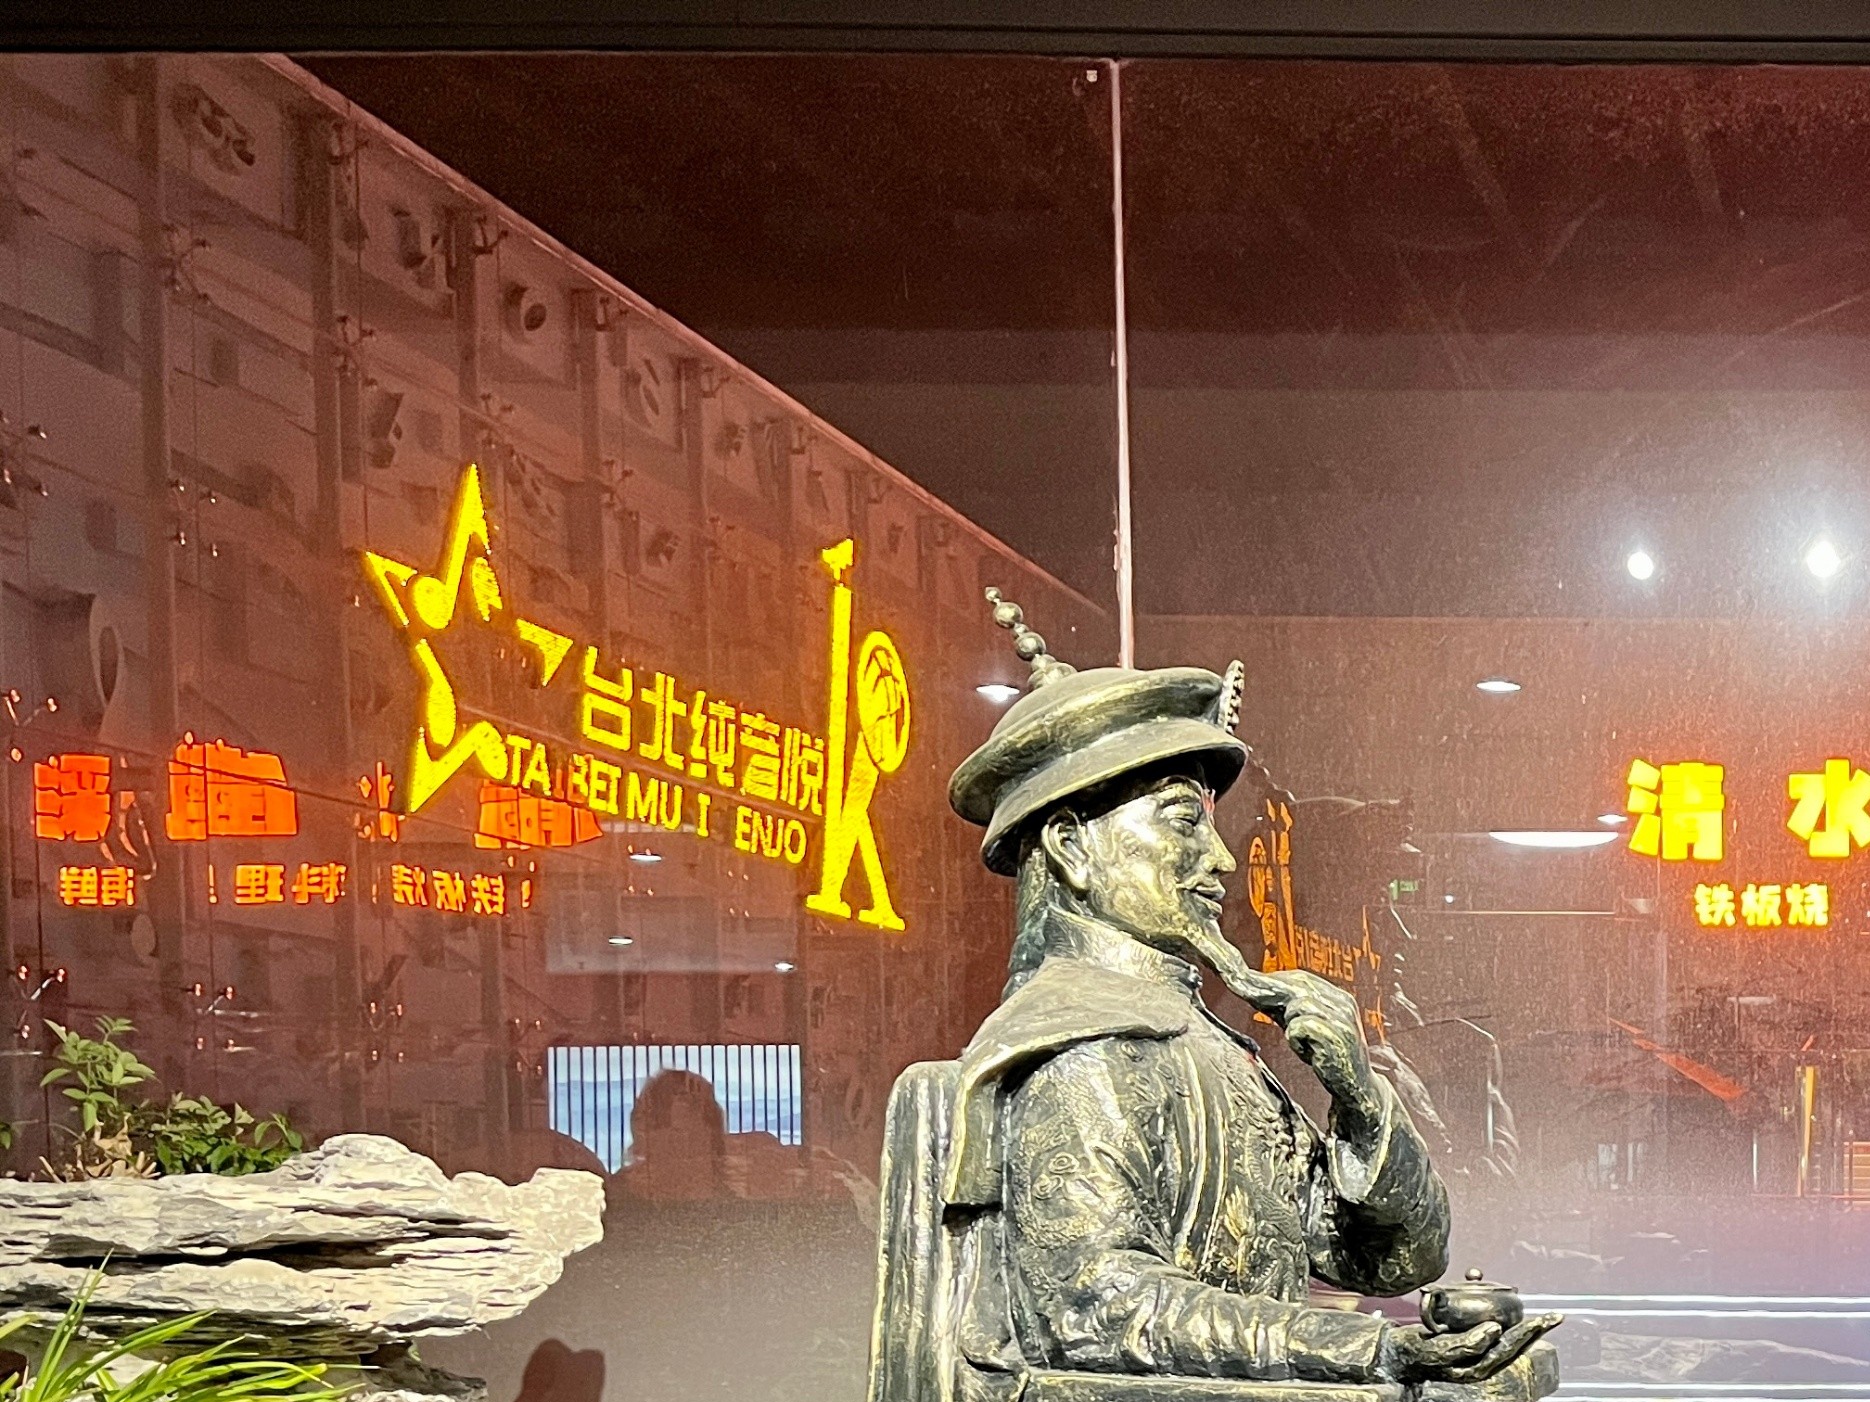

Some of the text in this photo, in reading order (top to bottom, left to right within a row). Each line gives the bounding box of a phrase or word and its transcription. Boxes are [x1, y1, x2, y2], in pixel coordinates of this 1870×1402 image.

[583, 646, 824, 816] 台北纯音悦
[1693, 884, 1829, 928] 铁板烧
